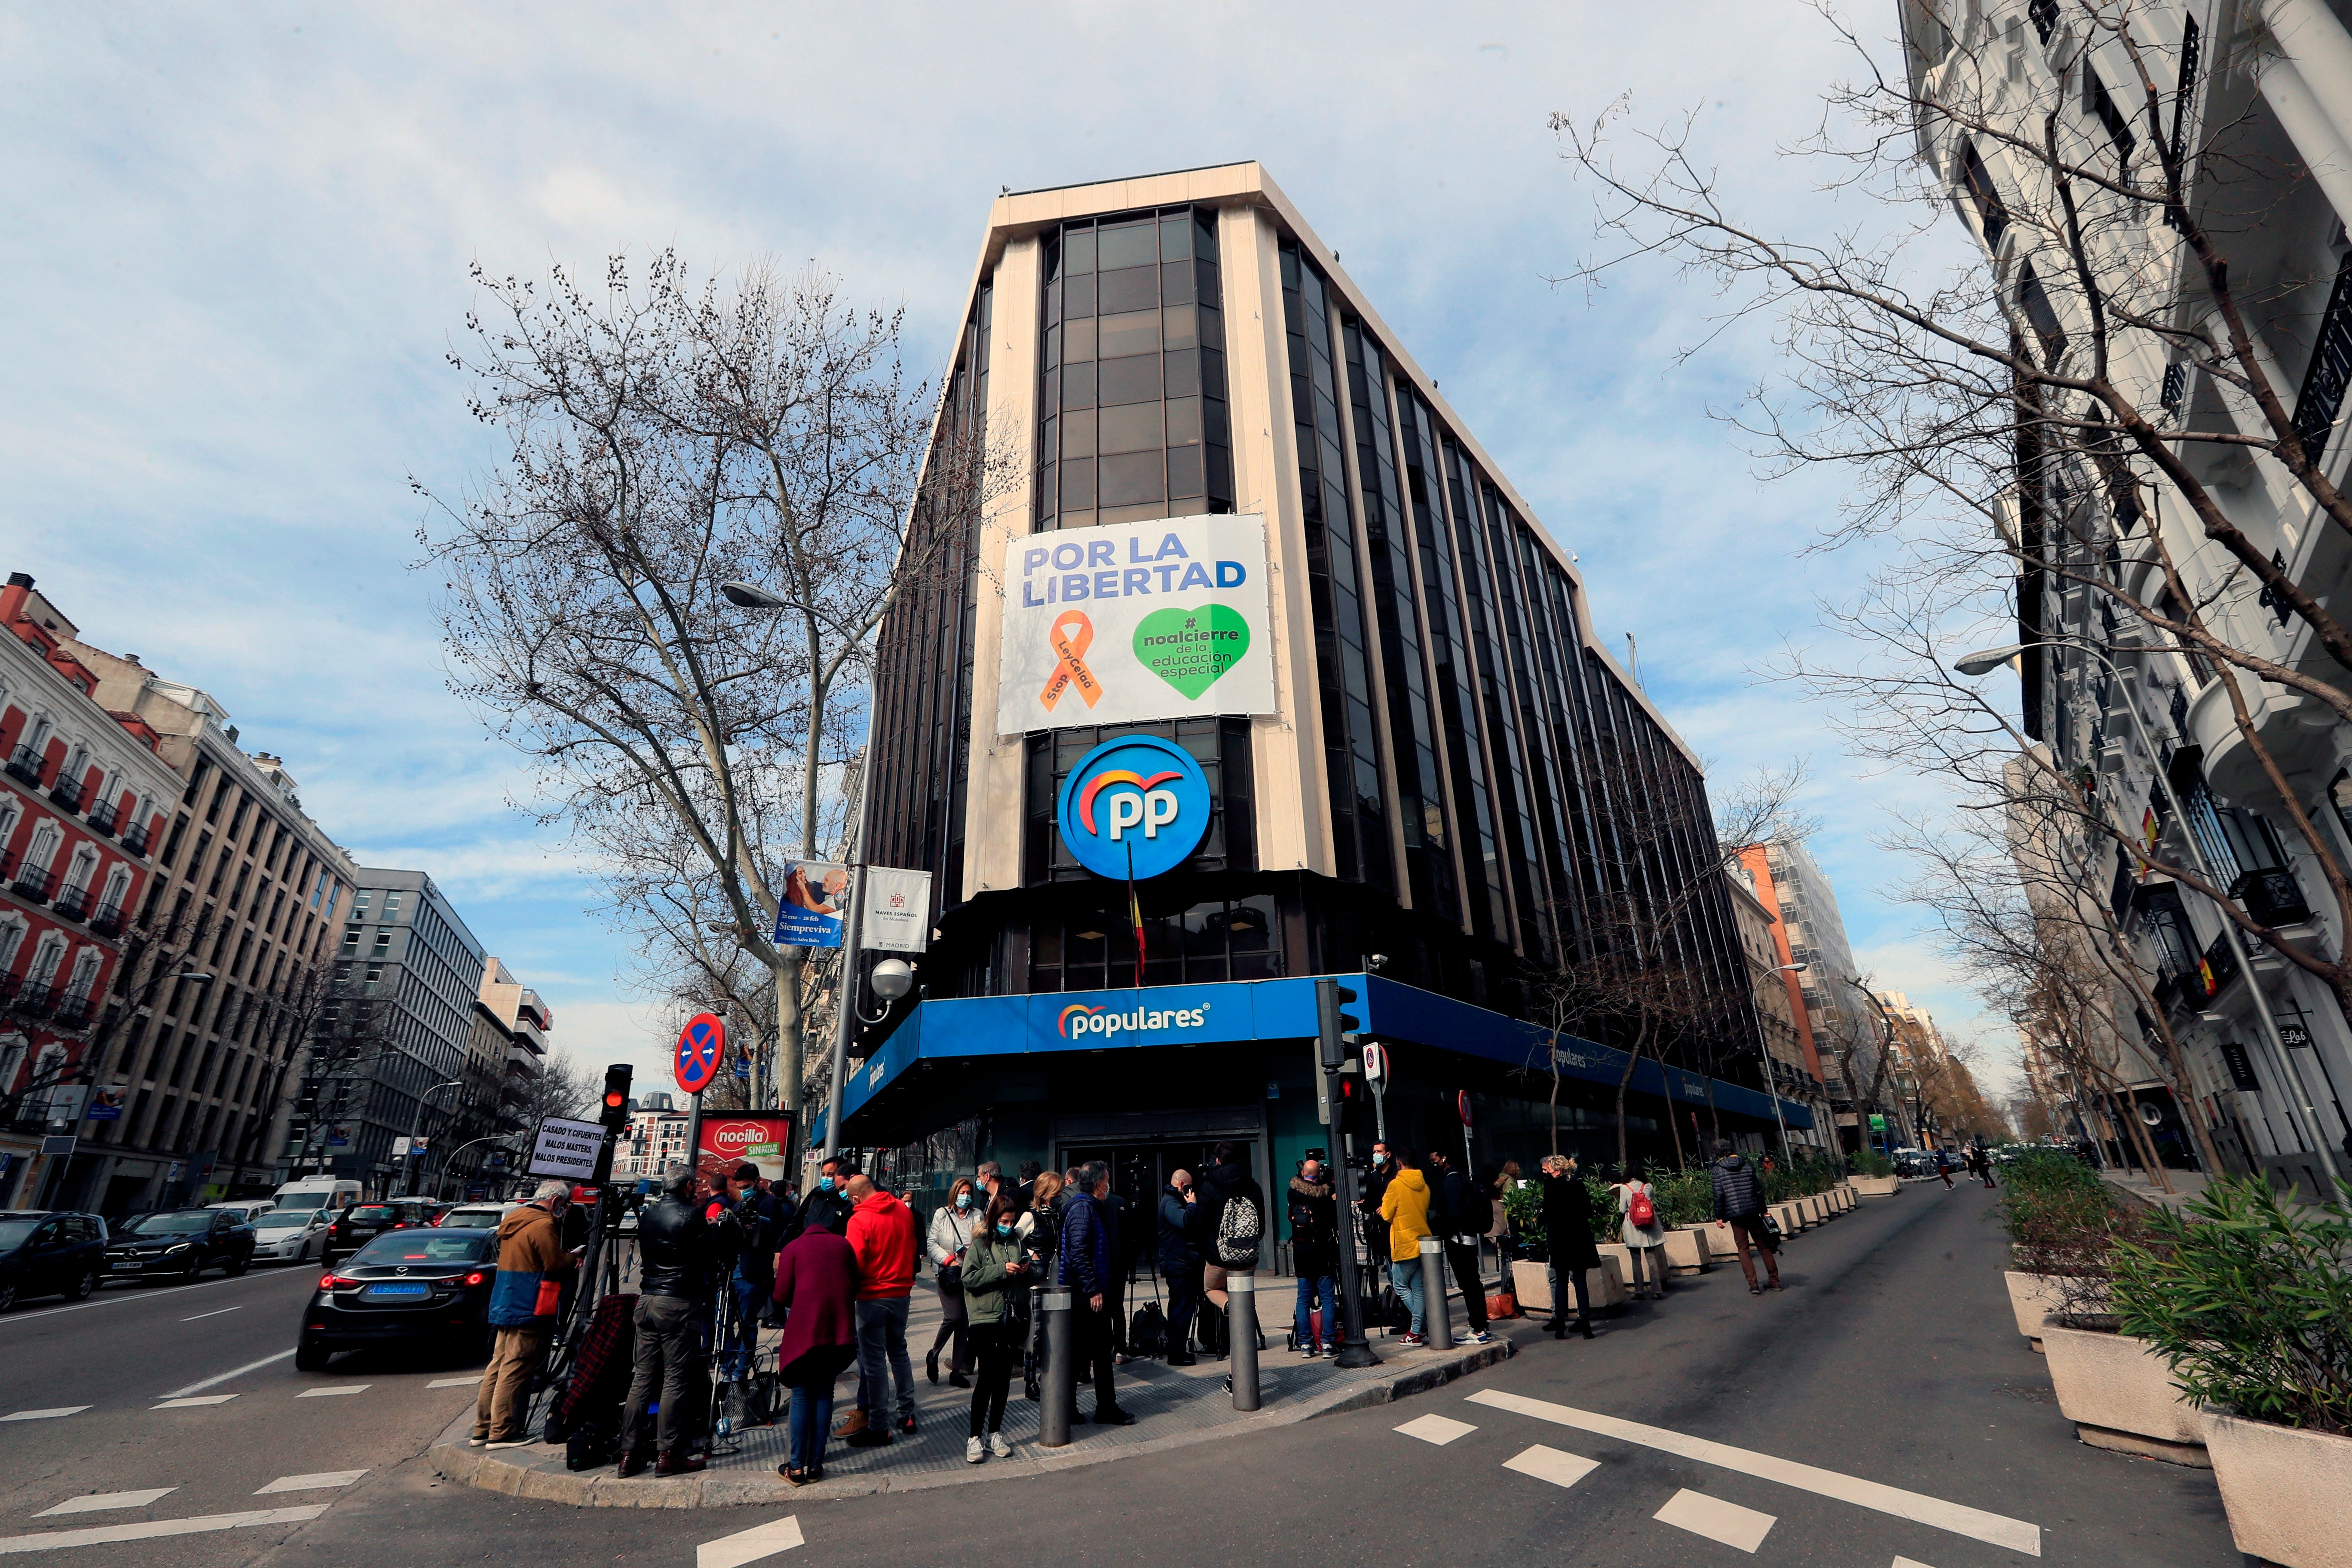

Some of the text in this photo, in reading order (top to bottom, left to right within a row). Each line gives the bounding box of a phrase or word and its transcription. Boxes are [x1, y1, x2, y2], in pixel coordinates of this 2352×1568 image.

[1024, 533, 1189, 576] POR LA
[1022, 560, 1246, 608] LIBERTAD
[1144, 629, 1239, 646] noalcierre
[1176, 643, 1207, 653] de la
[1058, 640, 1093, 689] LeyCelaá
[1152, 651, 1232, 667] educación
[1161, 662, 1225, 679] especial
[1047, 674, 1068, 701] Stop
[779, 922, 831, 934] Siempreviva
[1072, 1006, 1204, 1040] populares
[542, 1124, 567, 1136] CASADO
[572, 1130, 602, 1143] CIFUENTES,
[719, 1129, 763, 1142] nocilla
[545, 1139, 592, 1155] MALOS MASTERS,
[534, 1152, 593, 1168] MALOS PRESIDENTES.
[377, 1283, 423, 1292] 1900 HVH
